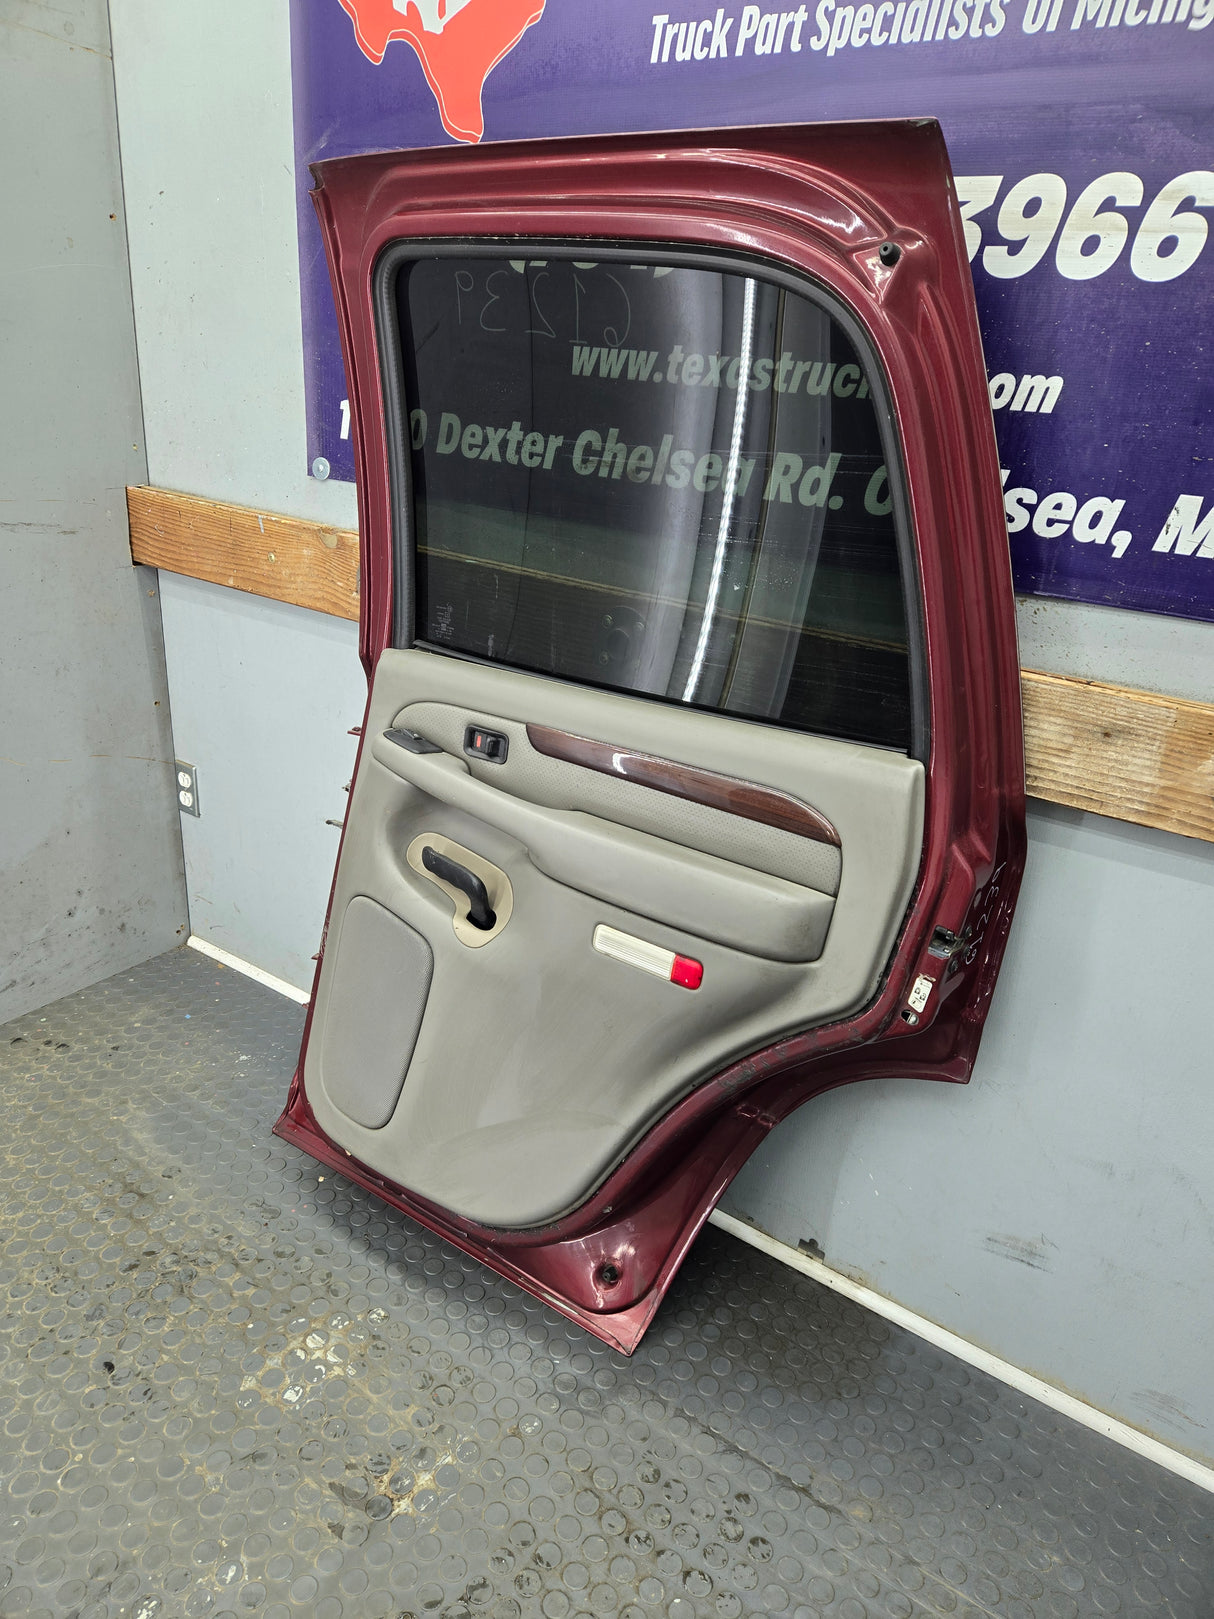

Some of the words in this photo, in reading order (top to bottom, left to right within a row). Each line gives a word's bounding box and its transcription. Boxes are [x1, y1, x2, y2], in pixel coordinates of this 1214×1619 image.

[650, 8, 734, 63] Truck
[735, 5, 808, 56] Part
[810, 0, 1006, 56] Specialists
[436, 412, 563, 470] Dexter
[572, 428, 755, 497] Chelsea
[763, 452, 844, 511] Rd.
